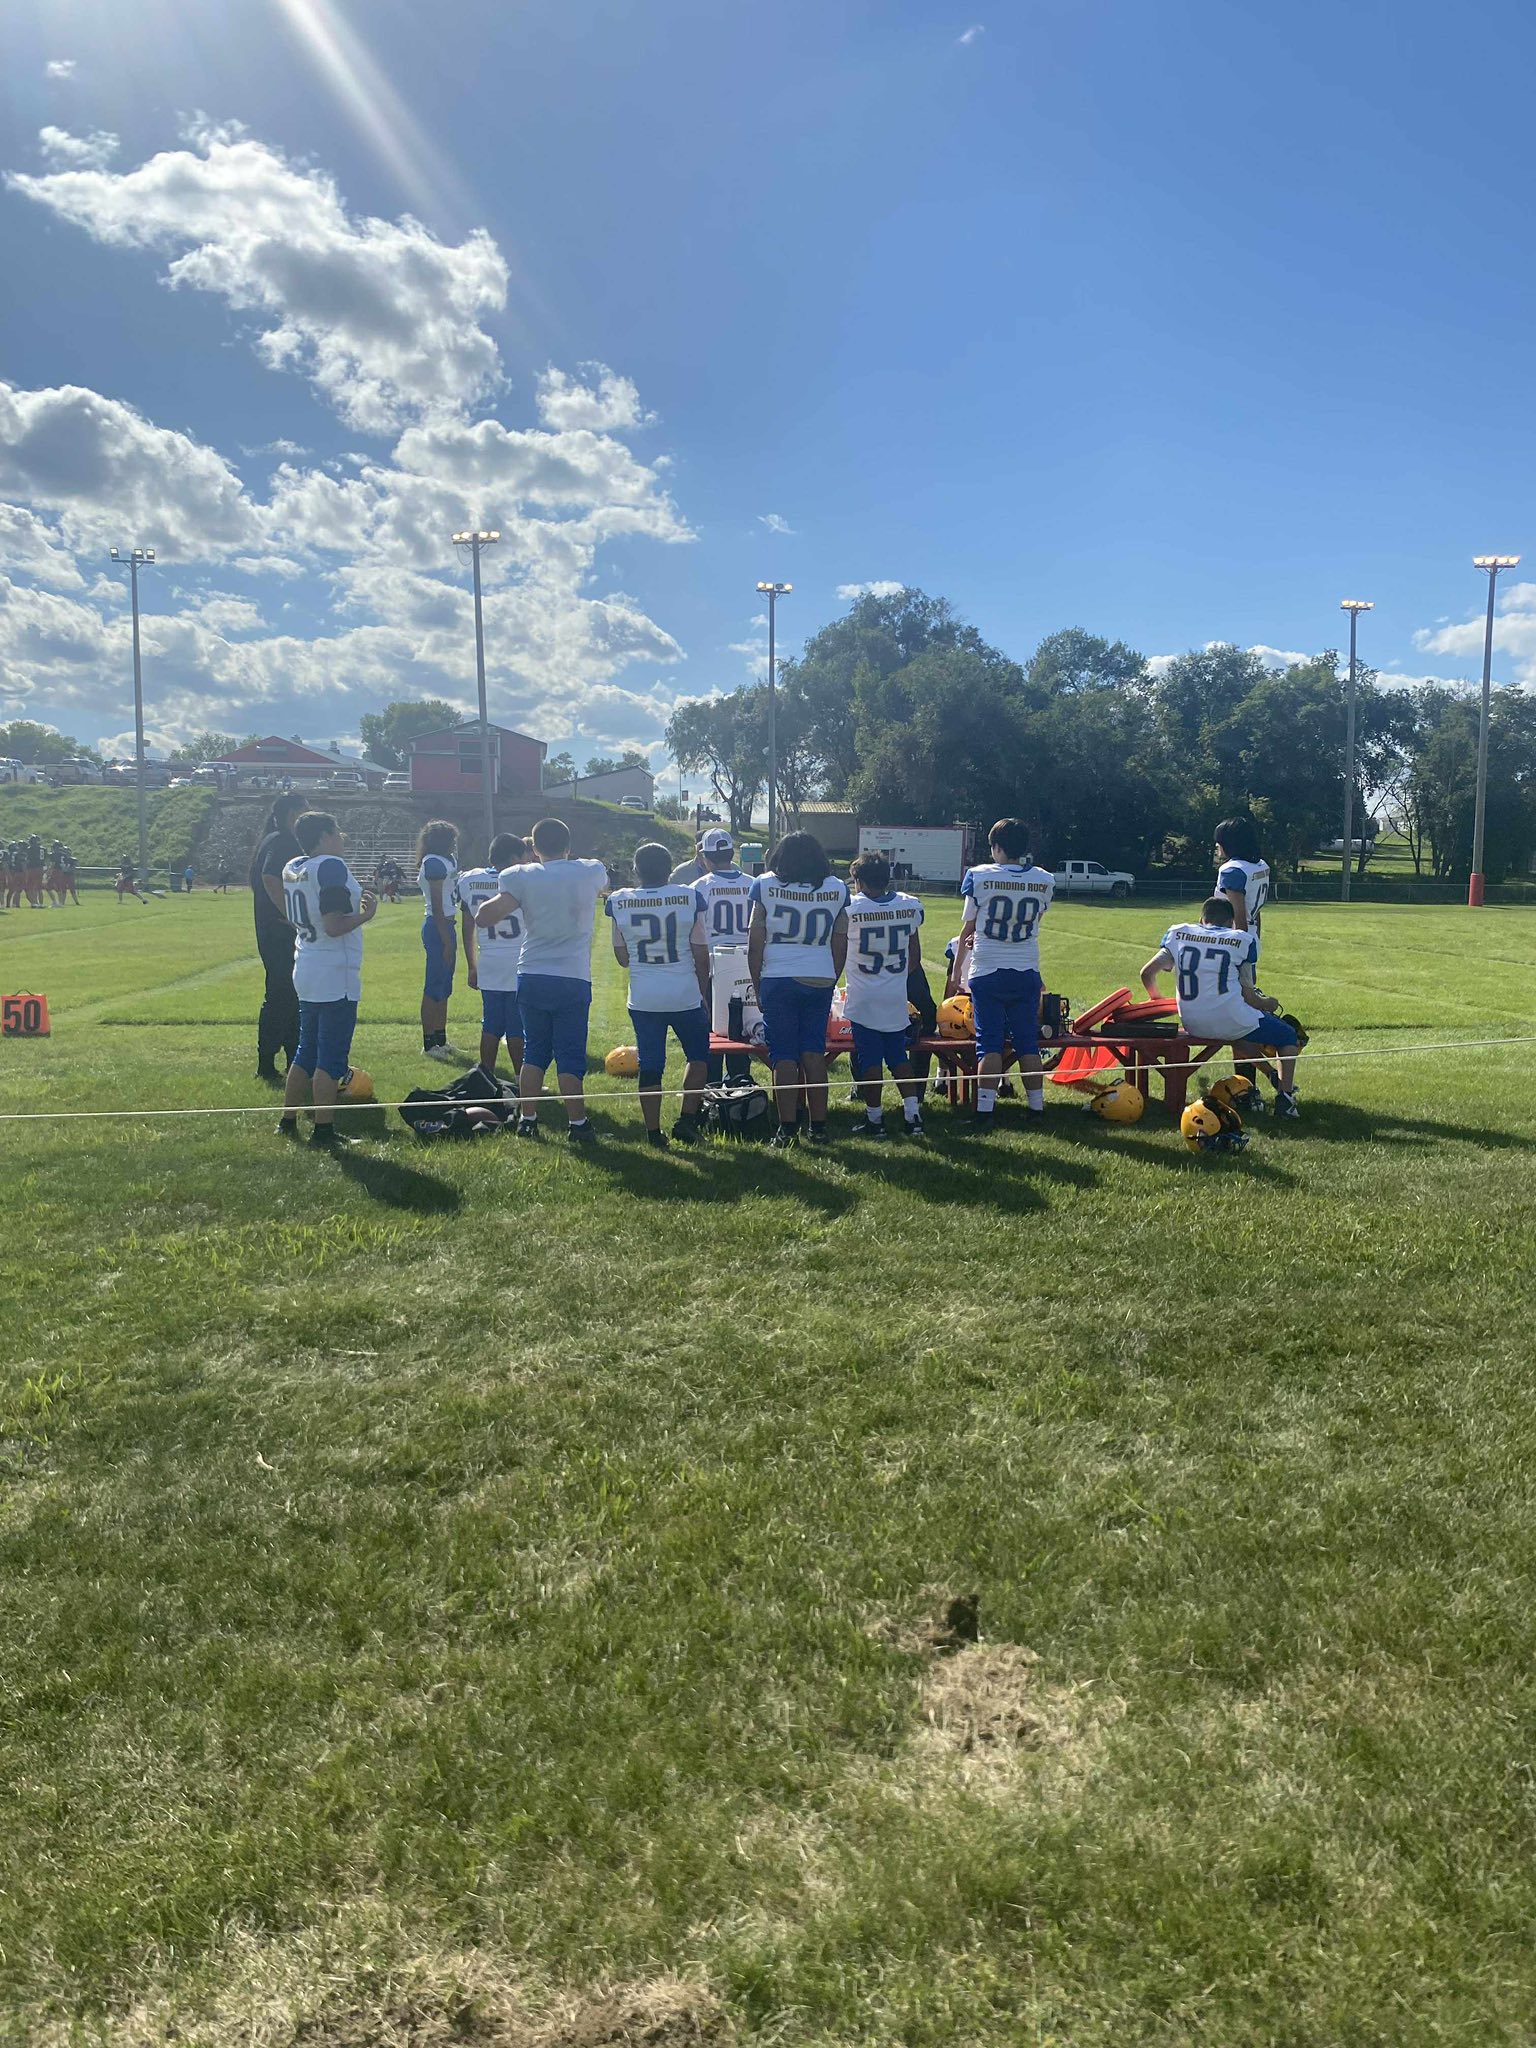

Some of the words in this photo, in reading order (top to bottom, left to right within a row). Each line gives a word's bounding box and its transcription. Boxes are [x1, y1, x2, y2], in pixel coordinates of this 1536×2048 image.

[617, 897, 663, 910] STANDING
[664, 895, 690, 906] ROCK
[768, 886, 814, 902] STANDING
[816, 889, 841, 902] ROCK
[983, 880, 1026, 892] STANDING
[769, 904, 835, 946] 20
[851, 909, 895, 923] STANDING
[984, 895, 1040, 943] 88
[630, 911, 680, 965] 21
[858, 923, 911, 975] 55
[1175, 931, 1217, 945] STANDING
[1218, 936, 1242, 949] ROCK
[1178, 945, 1231, 1002] 87
[3, 999, 42, 1033] 50
